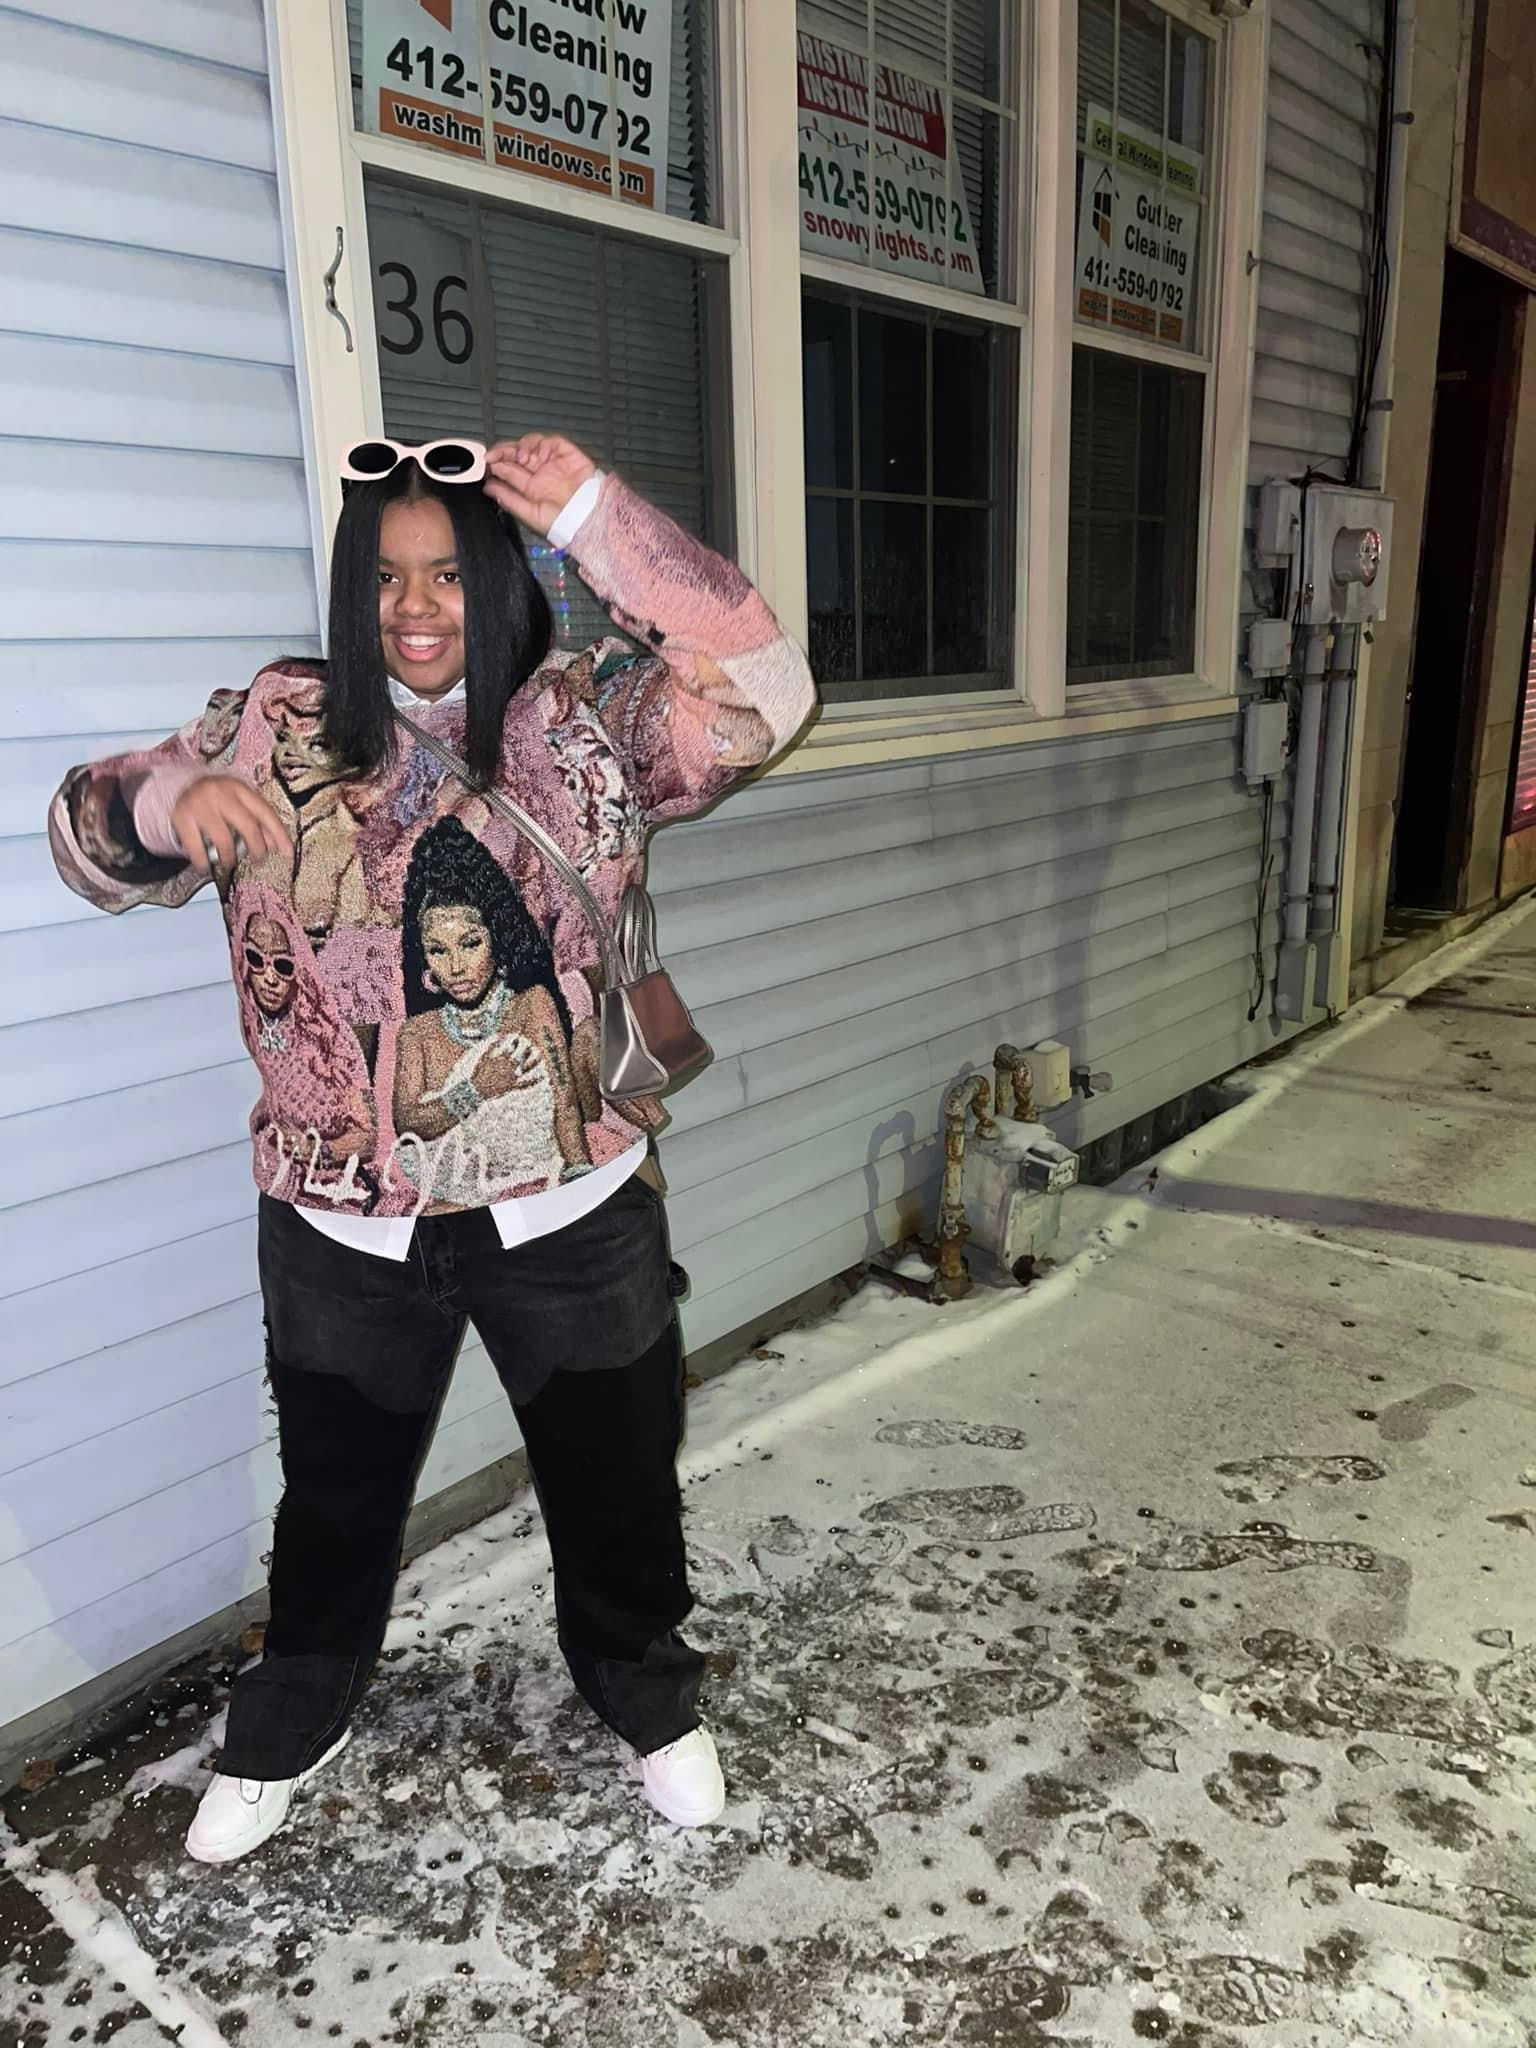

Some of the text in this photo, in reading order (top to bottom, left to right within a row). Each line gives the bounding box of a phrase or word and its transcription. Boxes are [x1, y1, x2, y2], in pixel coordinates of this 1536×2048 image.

[489, 0, 653, 98] Cleaning
[394, 103, 645, 194] washmwindows.cm
[800, 68, 929, 144] INSTALATION
[379, 262, 474, 365] 36
